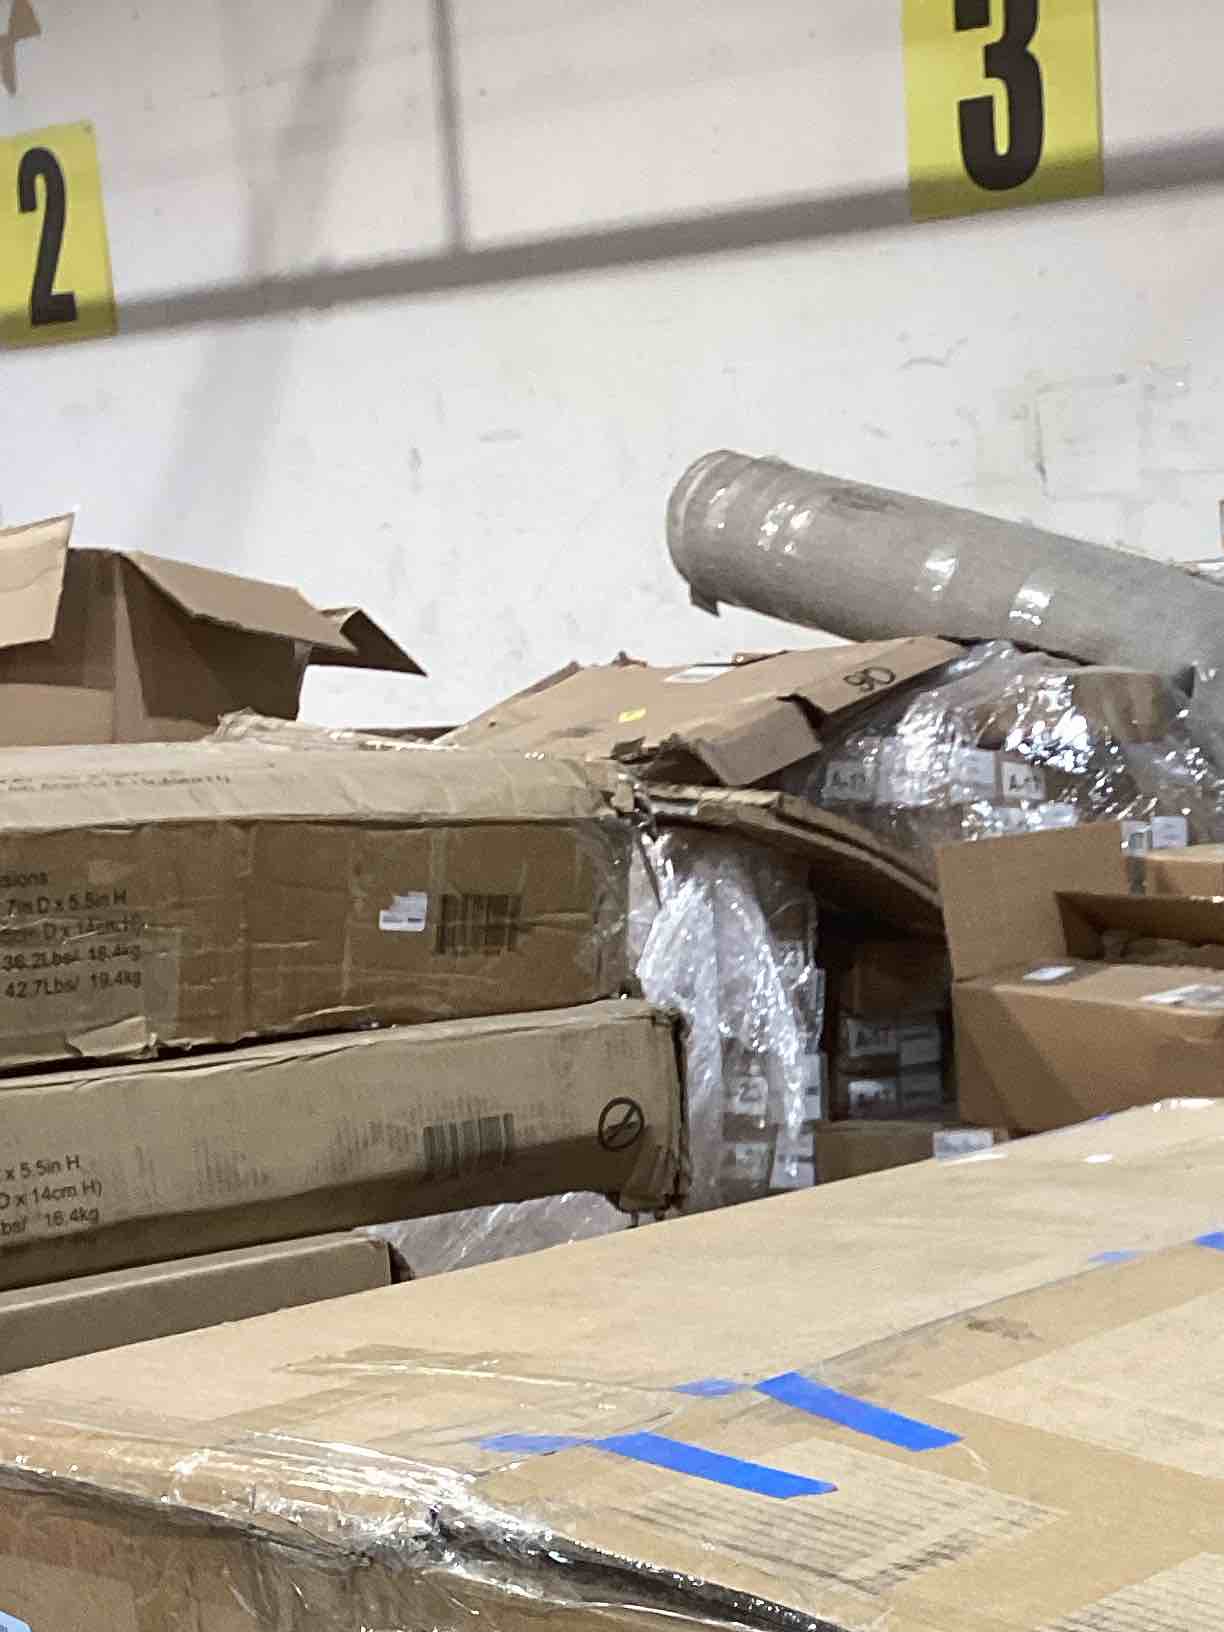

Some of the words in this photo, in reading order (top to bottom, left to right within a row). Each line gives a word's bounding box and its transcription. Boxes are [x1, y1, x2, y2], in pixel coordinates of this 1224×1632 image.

[953, 0, 1044, 192] 3
[15, 146, 78, 328] 2
[37, 896, 51, 914] D
[113, 887, 128, 905] H
[20, 1160, 61, 1179] 5.5in
[65, 1154, 80, 1171] H
[32, 1185, 78, 1203] 14cm
[82, 1178, 102, 1198] H)
